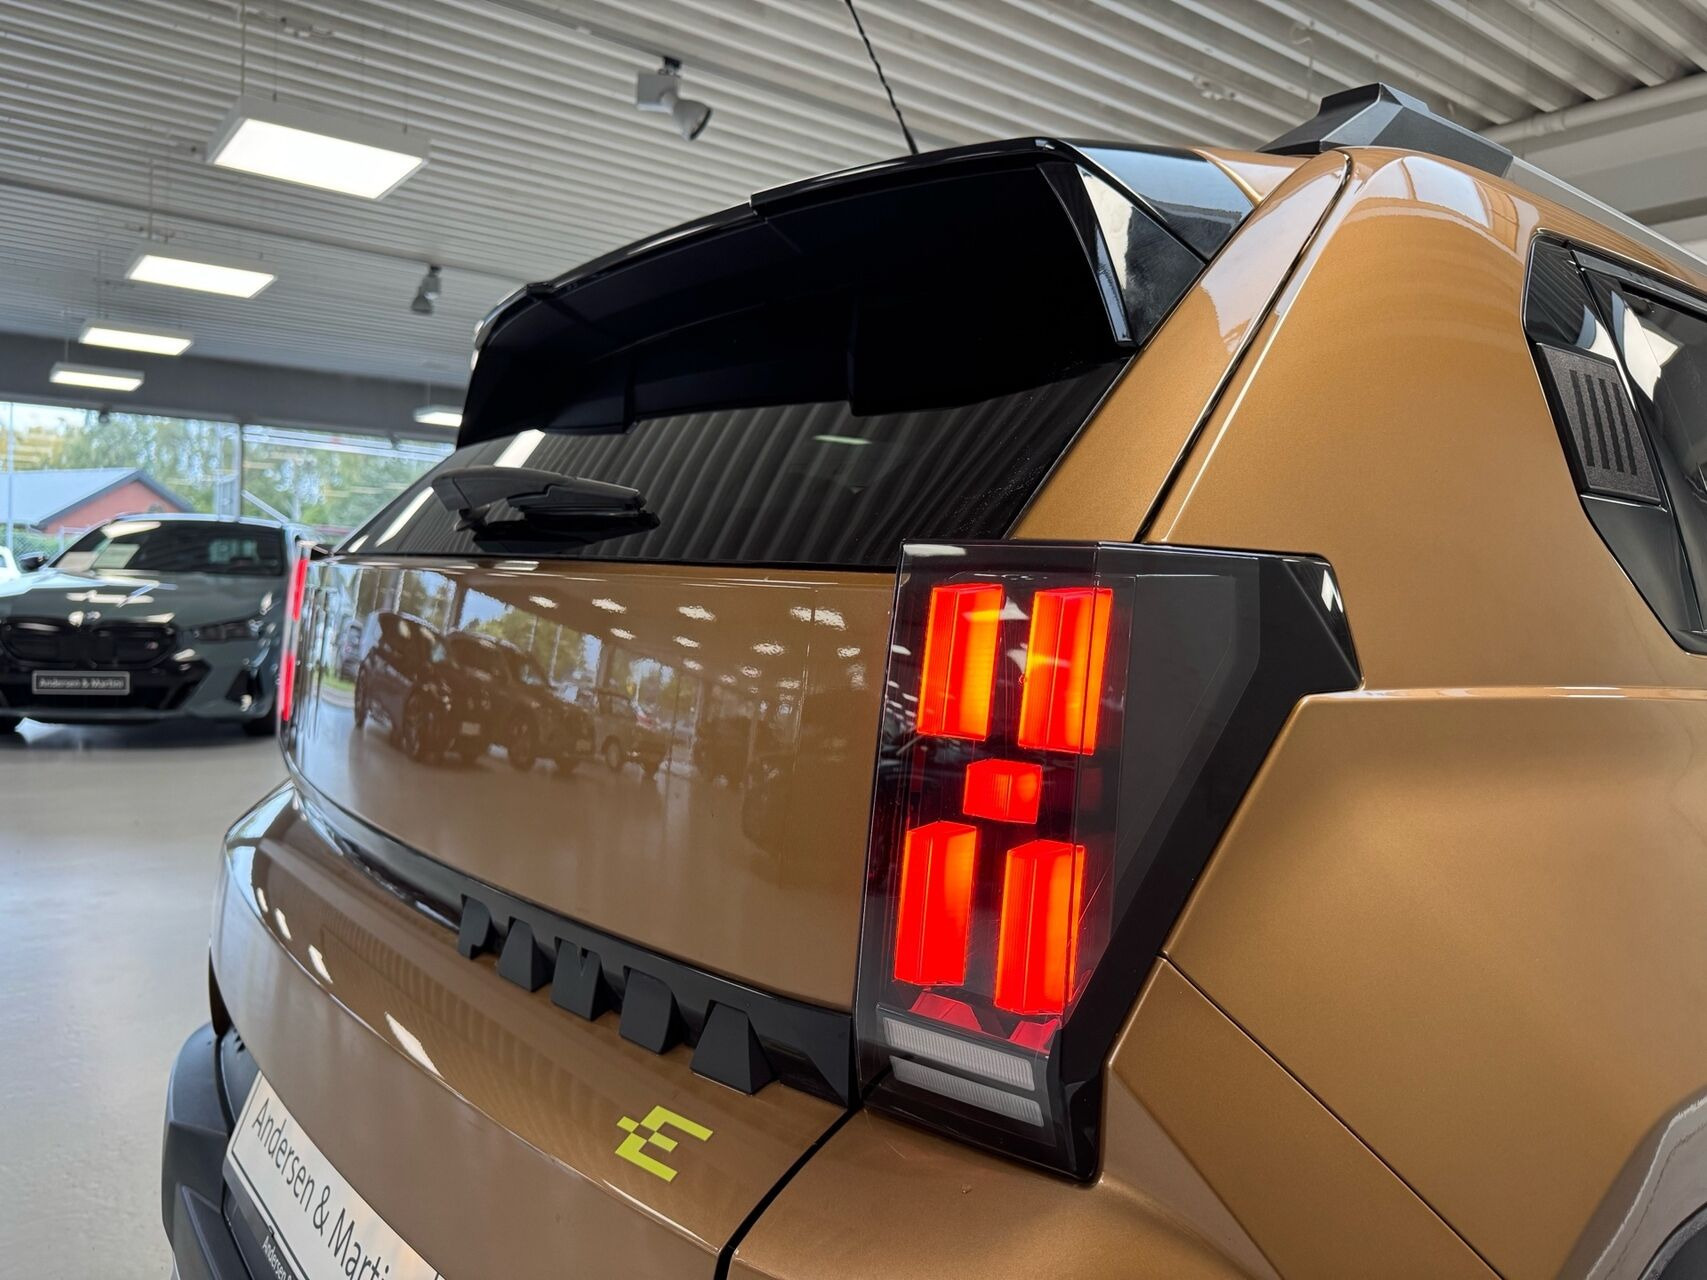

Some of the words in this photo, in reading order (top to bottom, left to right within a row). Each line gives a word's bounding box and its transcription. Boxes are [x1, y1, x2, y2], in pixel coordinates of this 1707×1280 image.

[40, 678, 80, 689] Andersen
[82, 678, 89, 689] &
[457, 894, 774, 1095] PANDA
[252, 1097, 316, 1212] Andersen
[313, 1185, 331, 1237] &
[262, 1235, 287, 1280] Andersen
